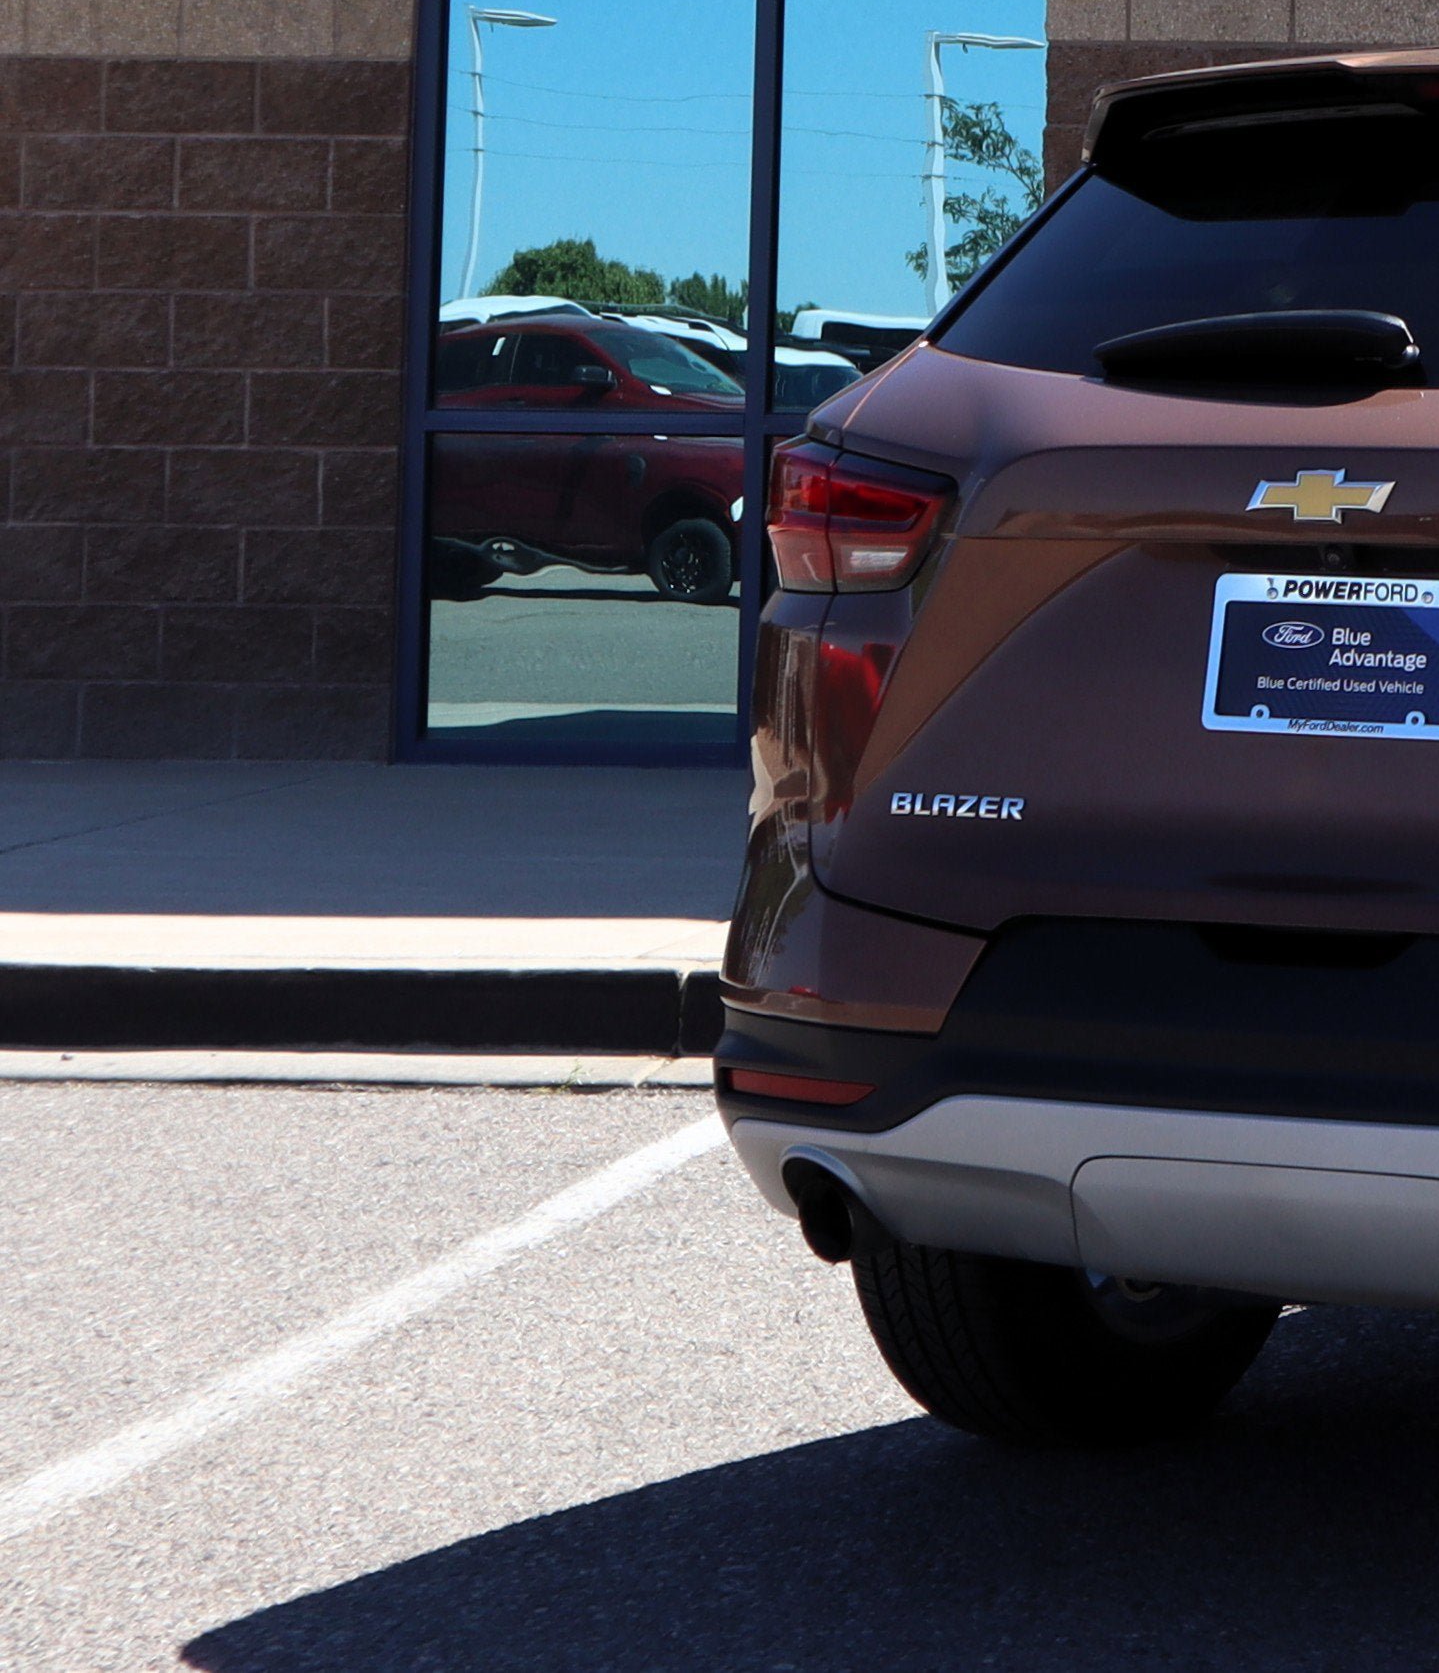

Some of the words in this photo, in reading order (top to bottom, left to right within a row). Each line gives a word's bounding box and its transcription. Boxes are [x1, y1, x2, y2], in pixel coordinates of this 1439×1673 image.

[1283, 580, 1418, 602] POWERFORD
[1274, 624, 1313, 644] Ford
[1332, 628, 1371, 646] Blue
[1329, 649, 1427, 672] Advantage
[1257, 677, 1284, 690] Blue
[1287, 677, 1340, 692] Certified
[1343, 681, 1375, 693] Used
[1379, 681, 1424, 695] Vehicle
[1287, 719, 1384, 734] MyFordDealer.com
[890, 792, 1025, 821] BLAZER
